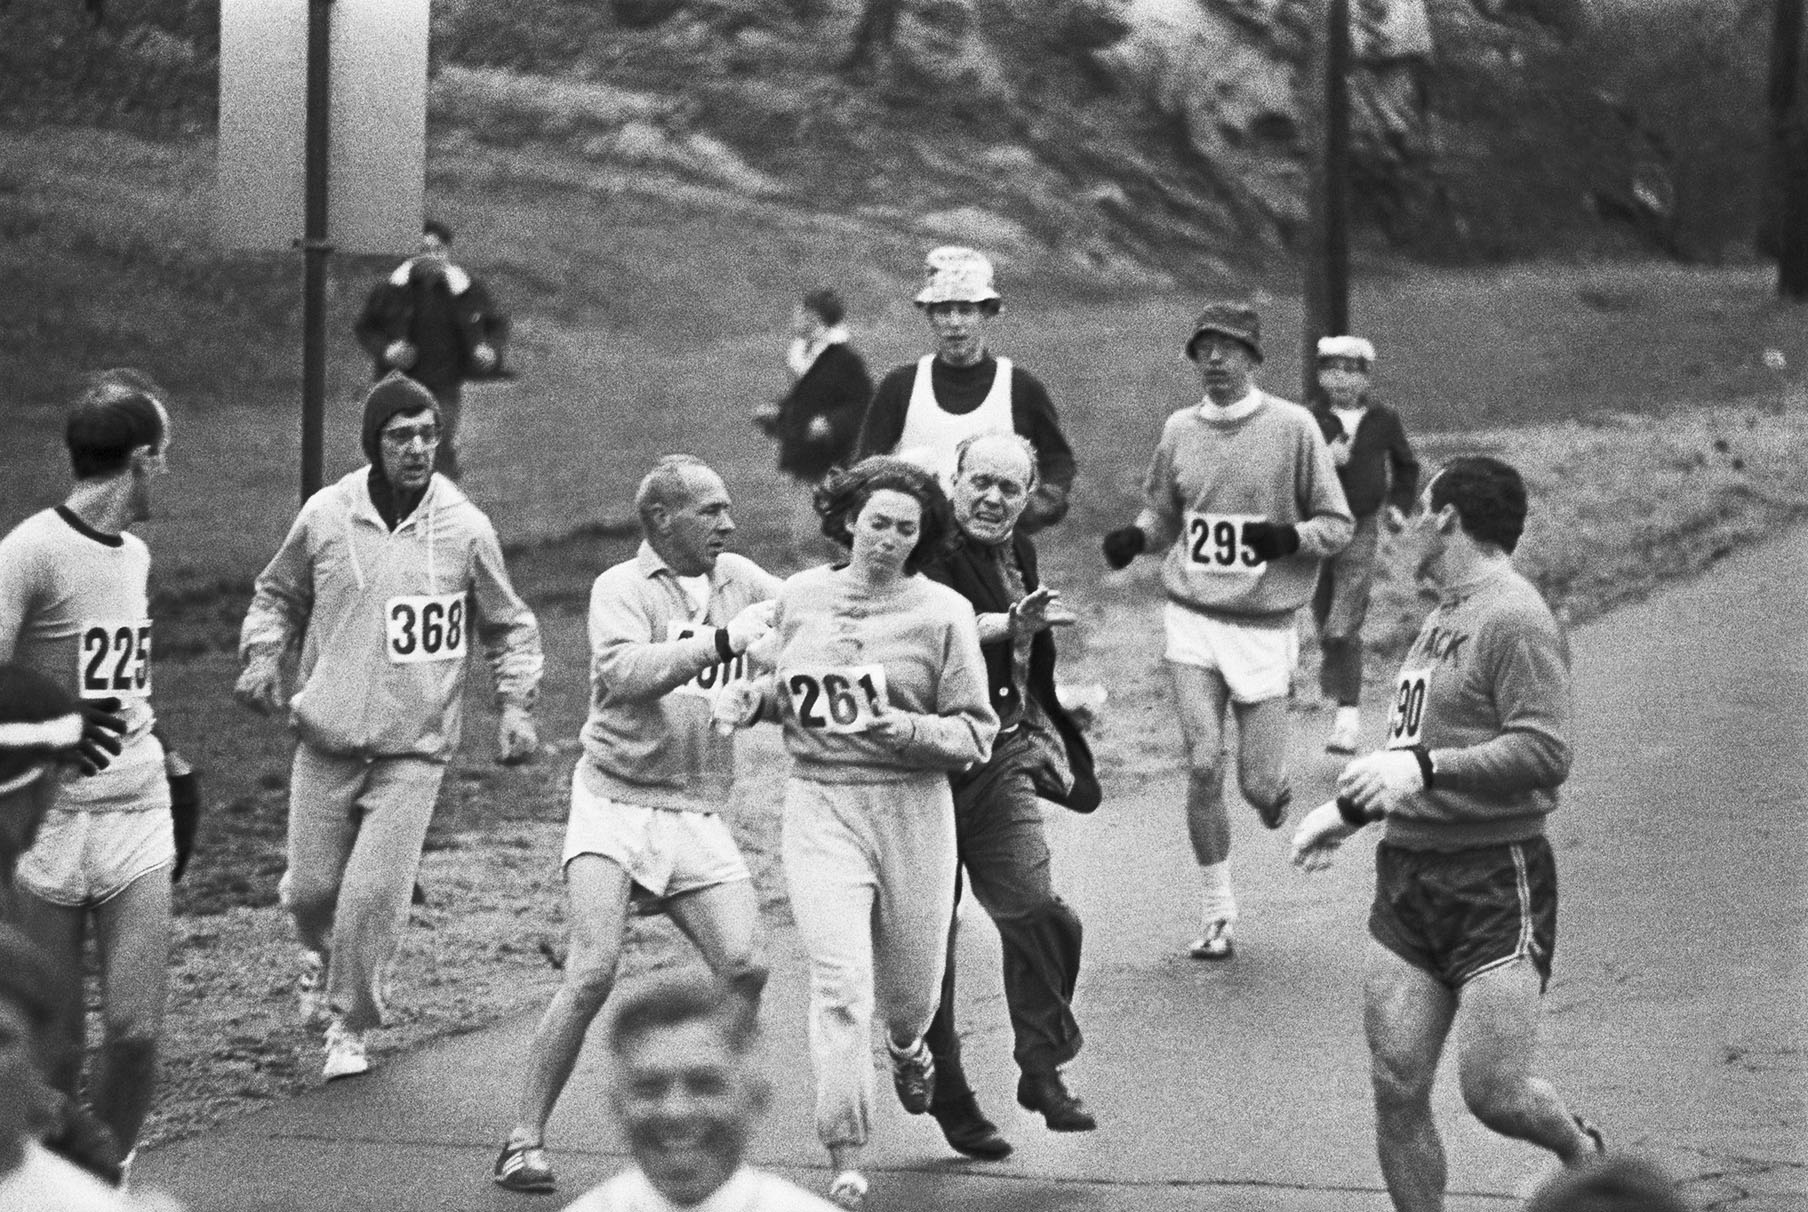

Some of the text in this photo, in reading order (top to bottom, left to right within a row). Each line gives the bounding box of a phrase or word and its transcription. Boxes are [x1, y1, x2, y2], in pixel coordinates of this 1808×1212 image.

[1191, 518, 1265, 567] 295
[391, 600, 462, 655] 368
[85, 626, 151, 690] 225
[790, 673, 883, 728] 261
[1390, 678, 1425, 738] 90
